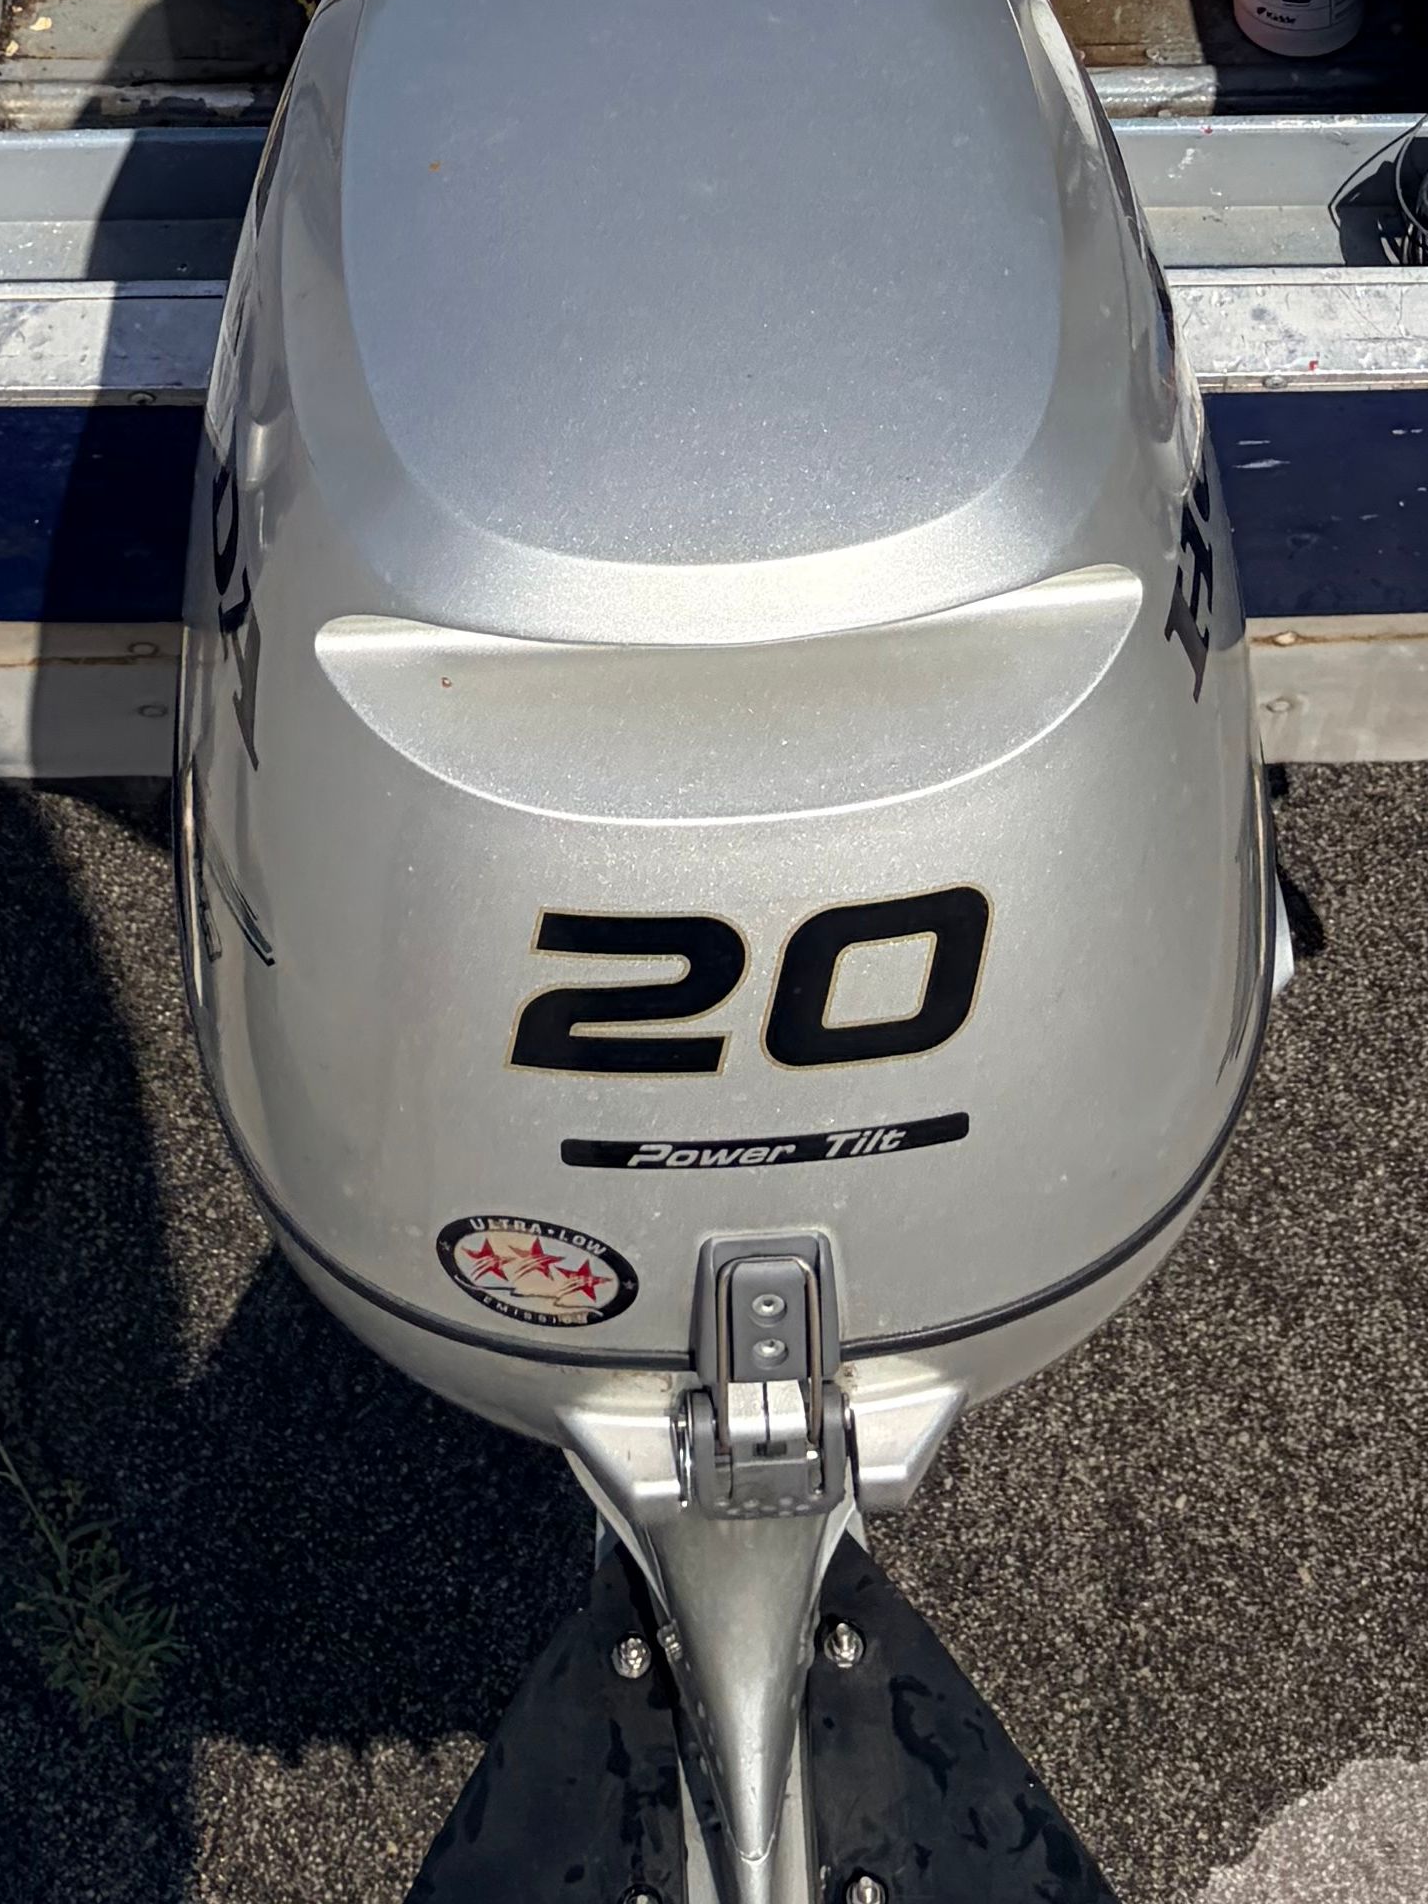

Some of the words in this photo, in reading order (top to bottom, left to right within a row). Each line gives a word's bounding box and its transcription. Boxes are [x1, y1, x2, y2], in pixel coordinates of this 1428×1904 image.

[506, 882, 993, 1078] 20
[628, 1142, 797, 1168] Power
[825, 1127, 907, 1159] Tilt
